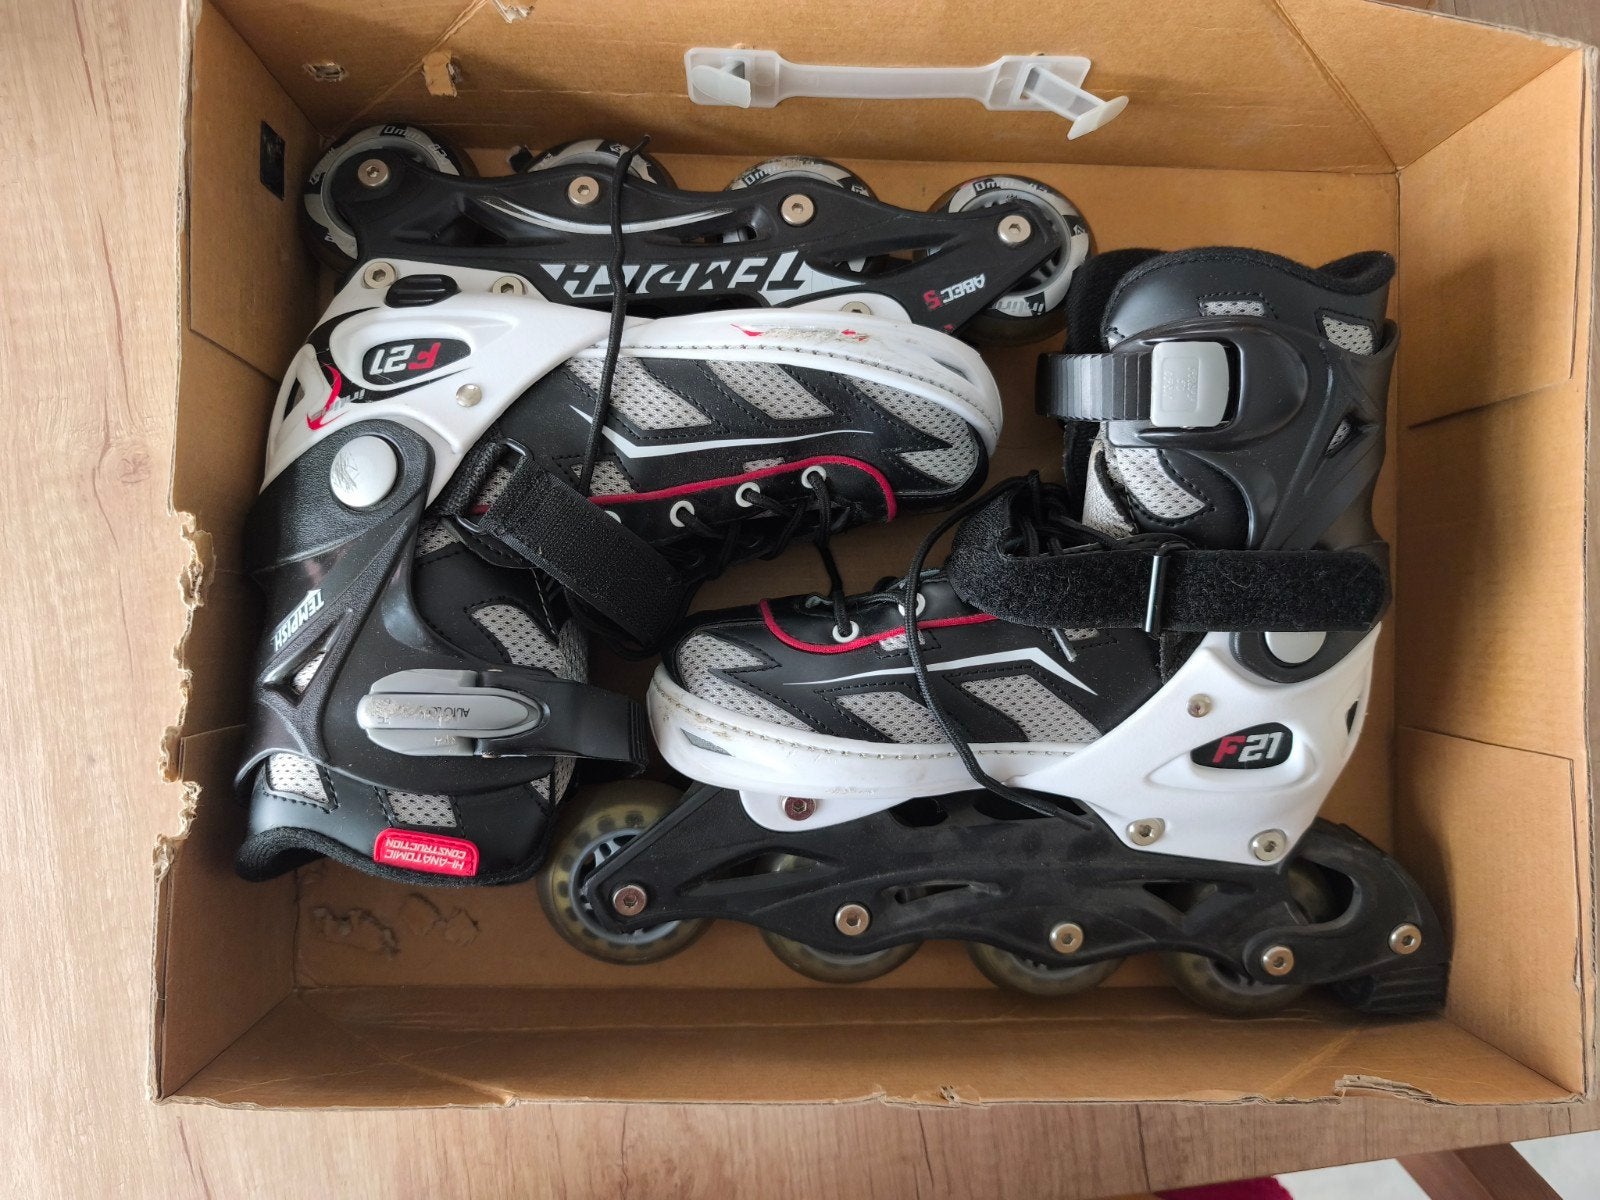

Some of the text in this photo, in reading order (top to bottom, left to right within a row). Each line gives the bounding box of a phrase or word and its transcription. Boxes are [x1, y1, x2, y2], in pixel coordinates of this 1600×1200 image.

[369, 342, 442, 376] F21
[272, 590, 325, 653] TEMPISH
[1212, 731, 1284, 764] F21
[384, 849, 465, 871] HI-ANATOMIC
[385, 837, 467, 860] CONSTRUCTION
